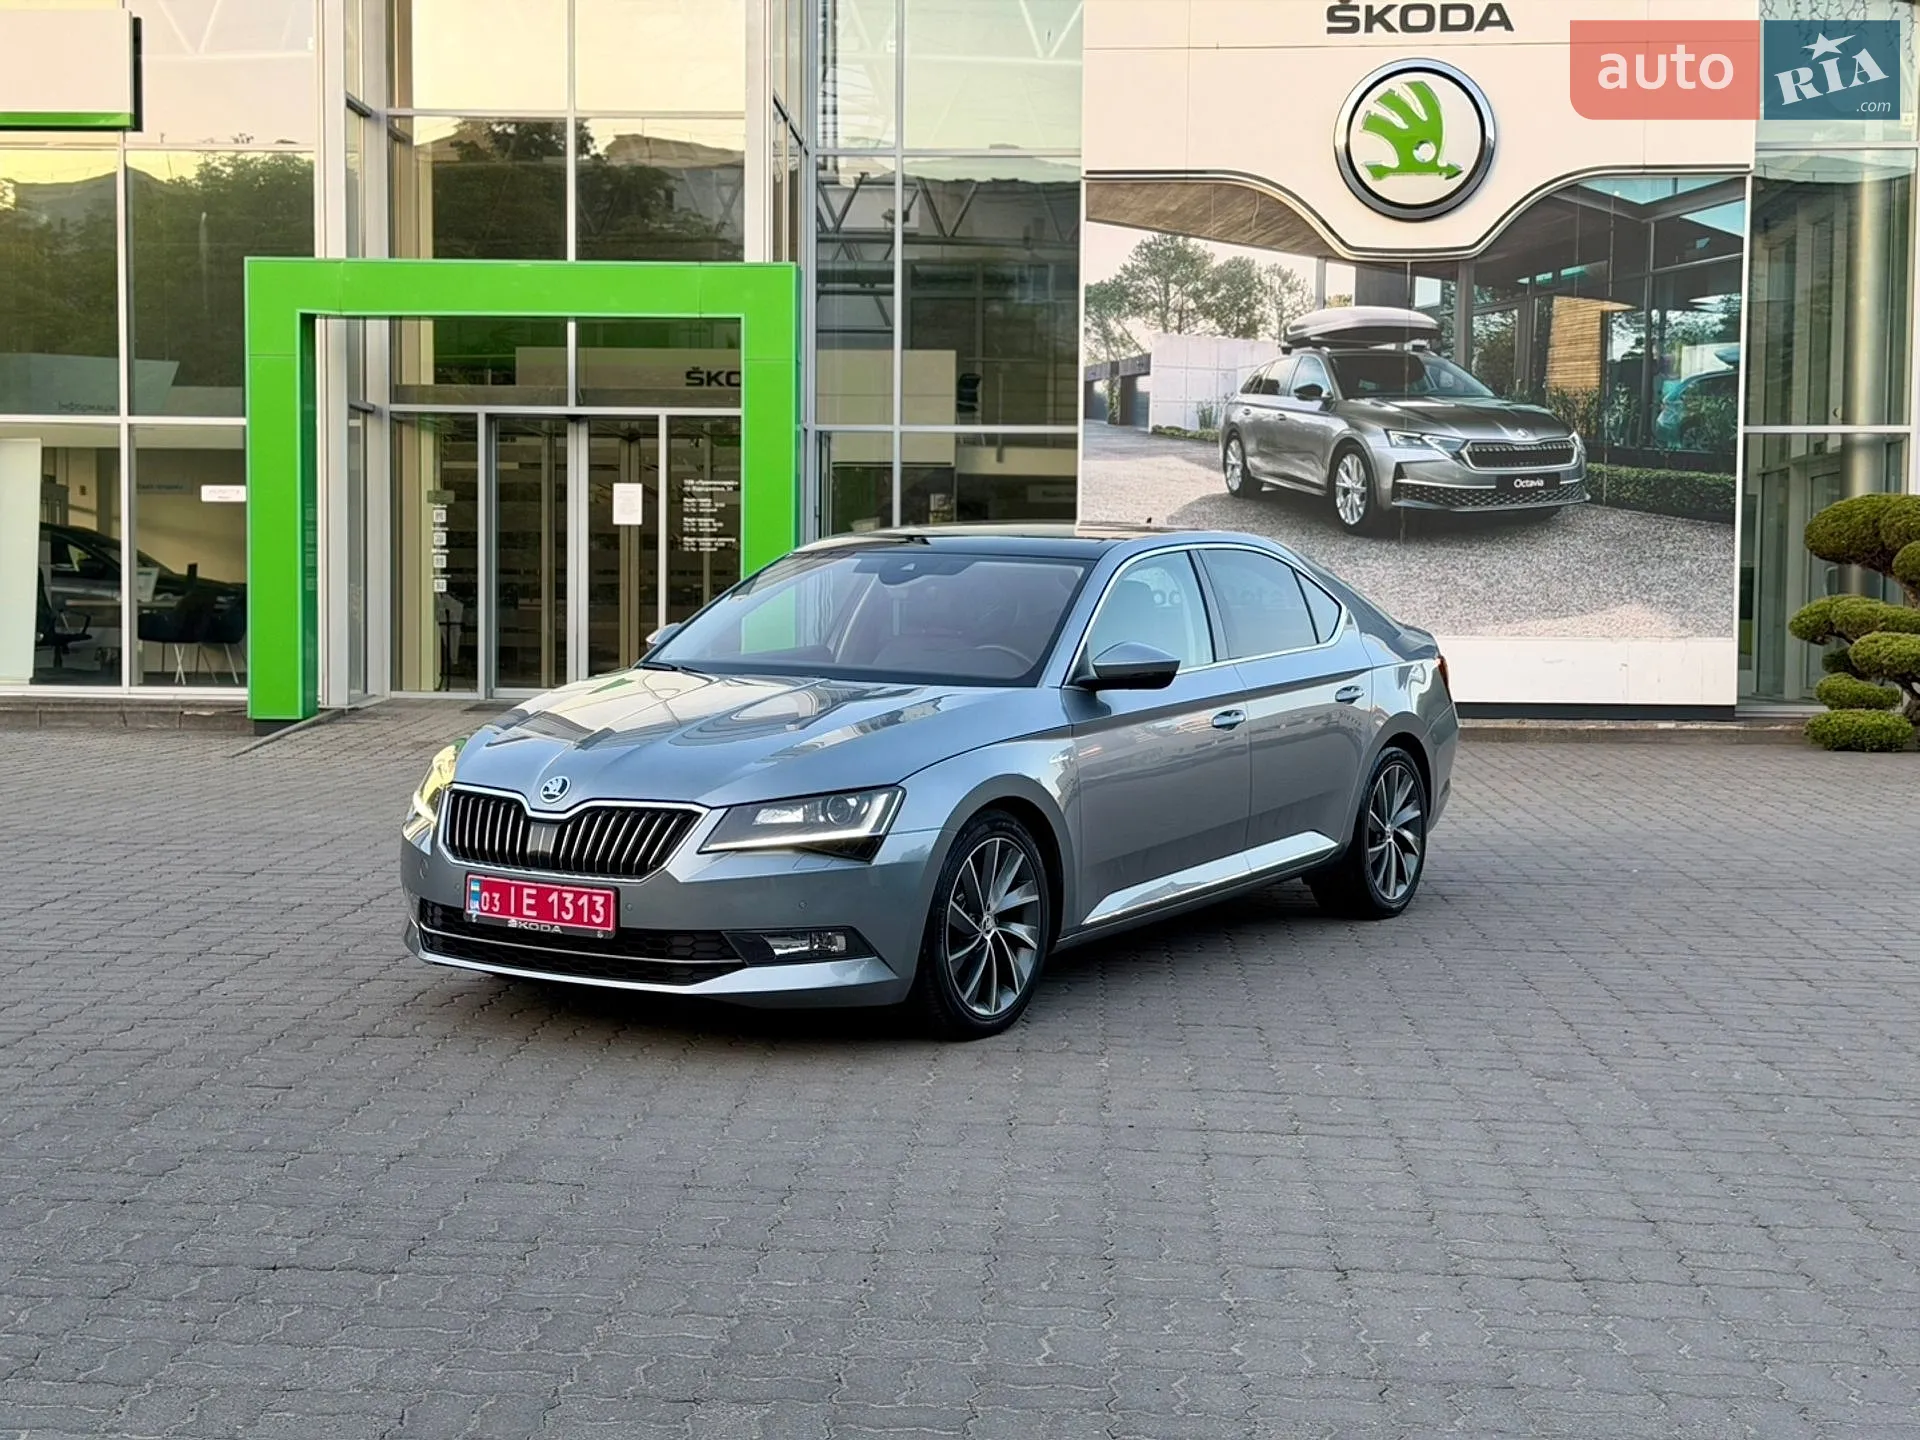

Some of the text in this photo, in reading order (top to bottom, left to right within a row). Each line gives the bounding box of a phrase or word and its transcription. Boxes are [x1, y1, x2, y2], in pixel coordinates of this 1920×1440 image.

[1326, 0, 1515, 34] ŠKODA
[685, 365, 741, 387] ŠKO
[1513, 478, 1544, 488] Octavia
[480, 891, 501, 913] 03
[510, 886, 538, 917] IE
[548, 891, 606, 924] 1313
